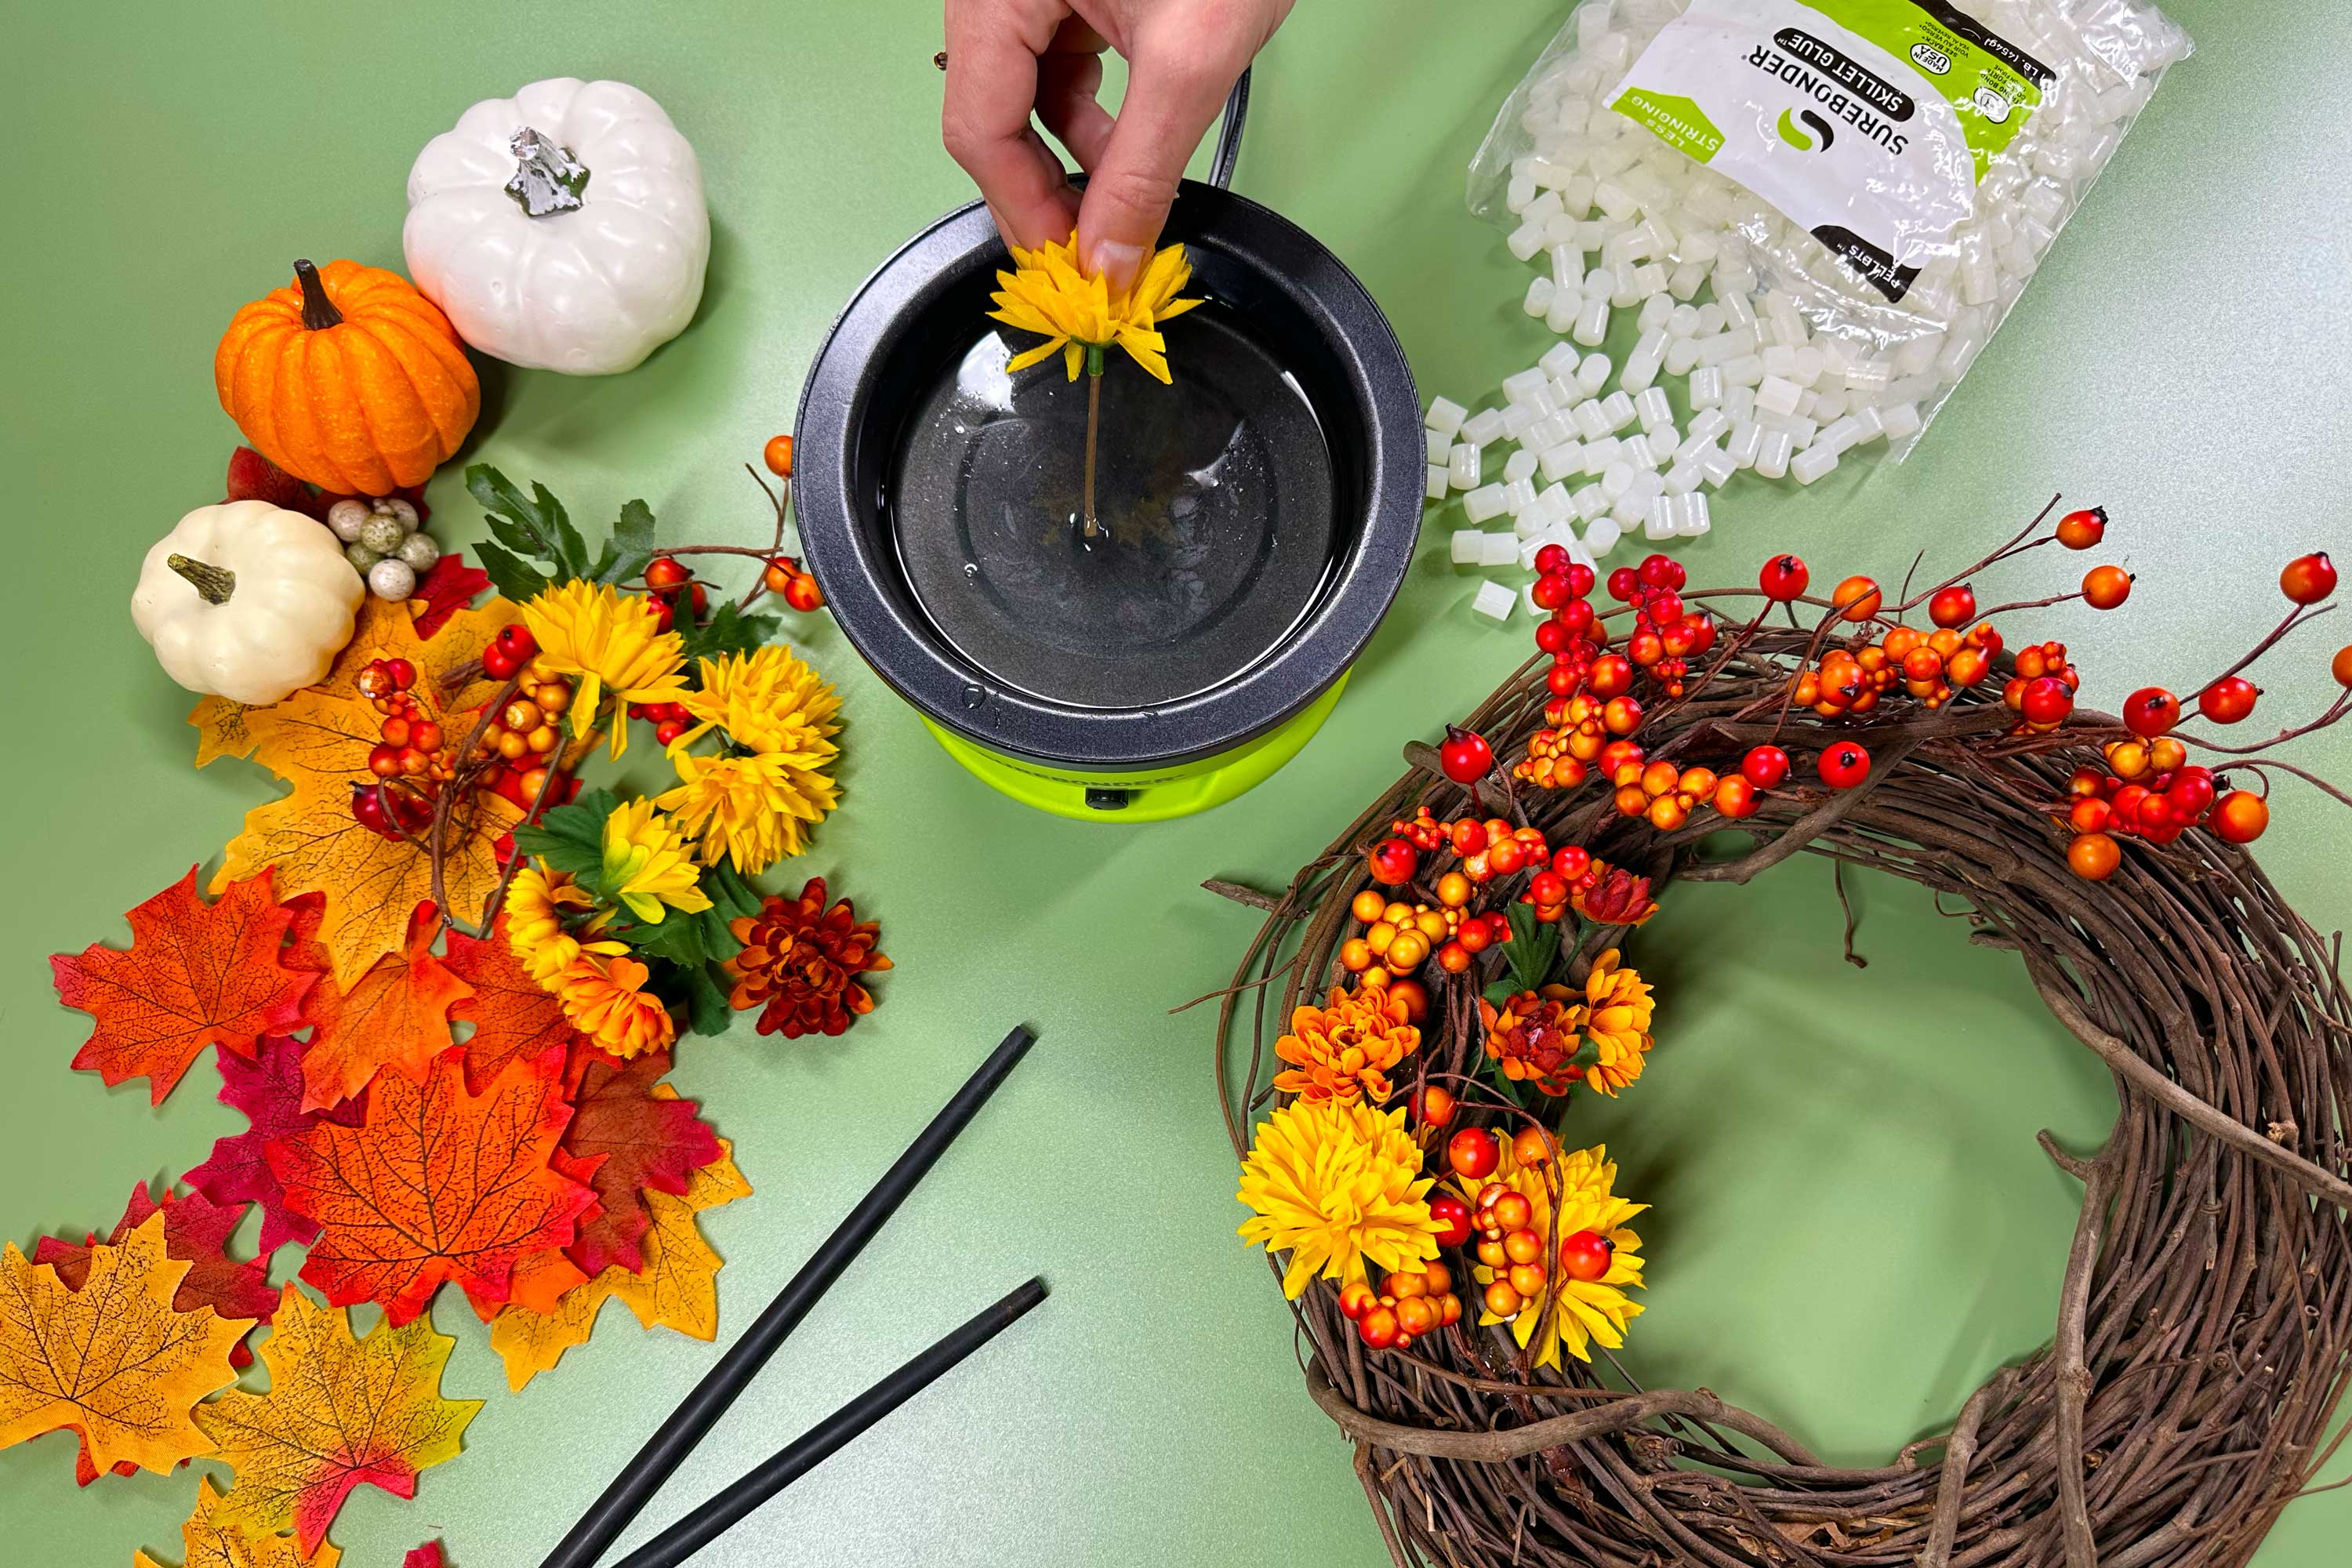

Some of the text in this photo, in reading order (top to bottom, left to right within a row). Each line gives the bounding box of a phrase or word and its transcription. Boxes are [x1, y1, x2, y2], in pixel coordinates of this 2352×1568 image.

[1944, 49, 1958, 57] SEE
[1954, 45, 1969, 59] VOIR
[1959, 42, 1969, 51] VEA
[1984, 38, 2019, 62] (454g)
[1921, 45, 1947, 67] USA
[1922, 56, 1943, 72] MADE
[1994, 64, 2010, 80] FIRME
[2022, 59, 2038, 76] LB.
[1987, 68, 2007, 85] FORTE
[1832, 62, 1903, 112] SKILLET
[1631, 96, 1719, 151] STRINGING
[1646, 118, 1685, 147] LESS
